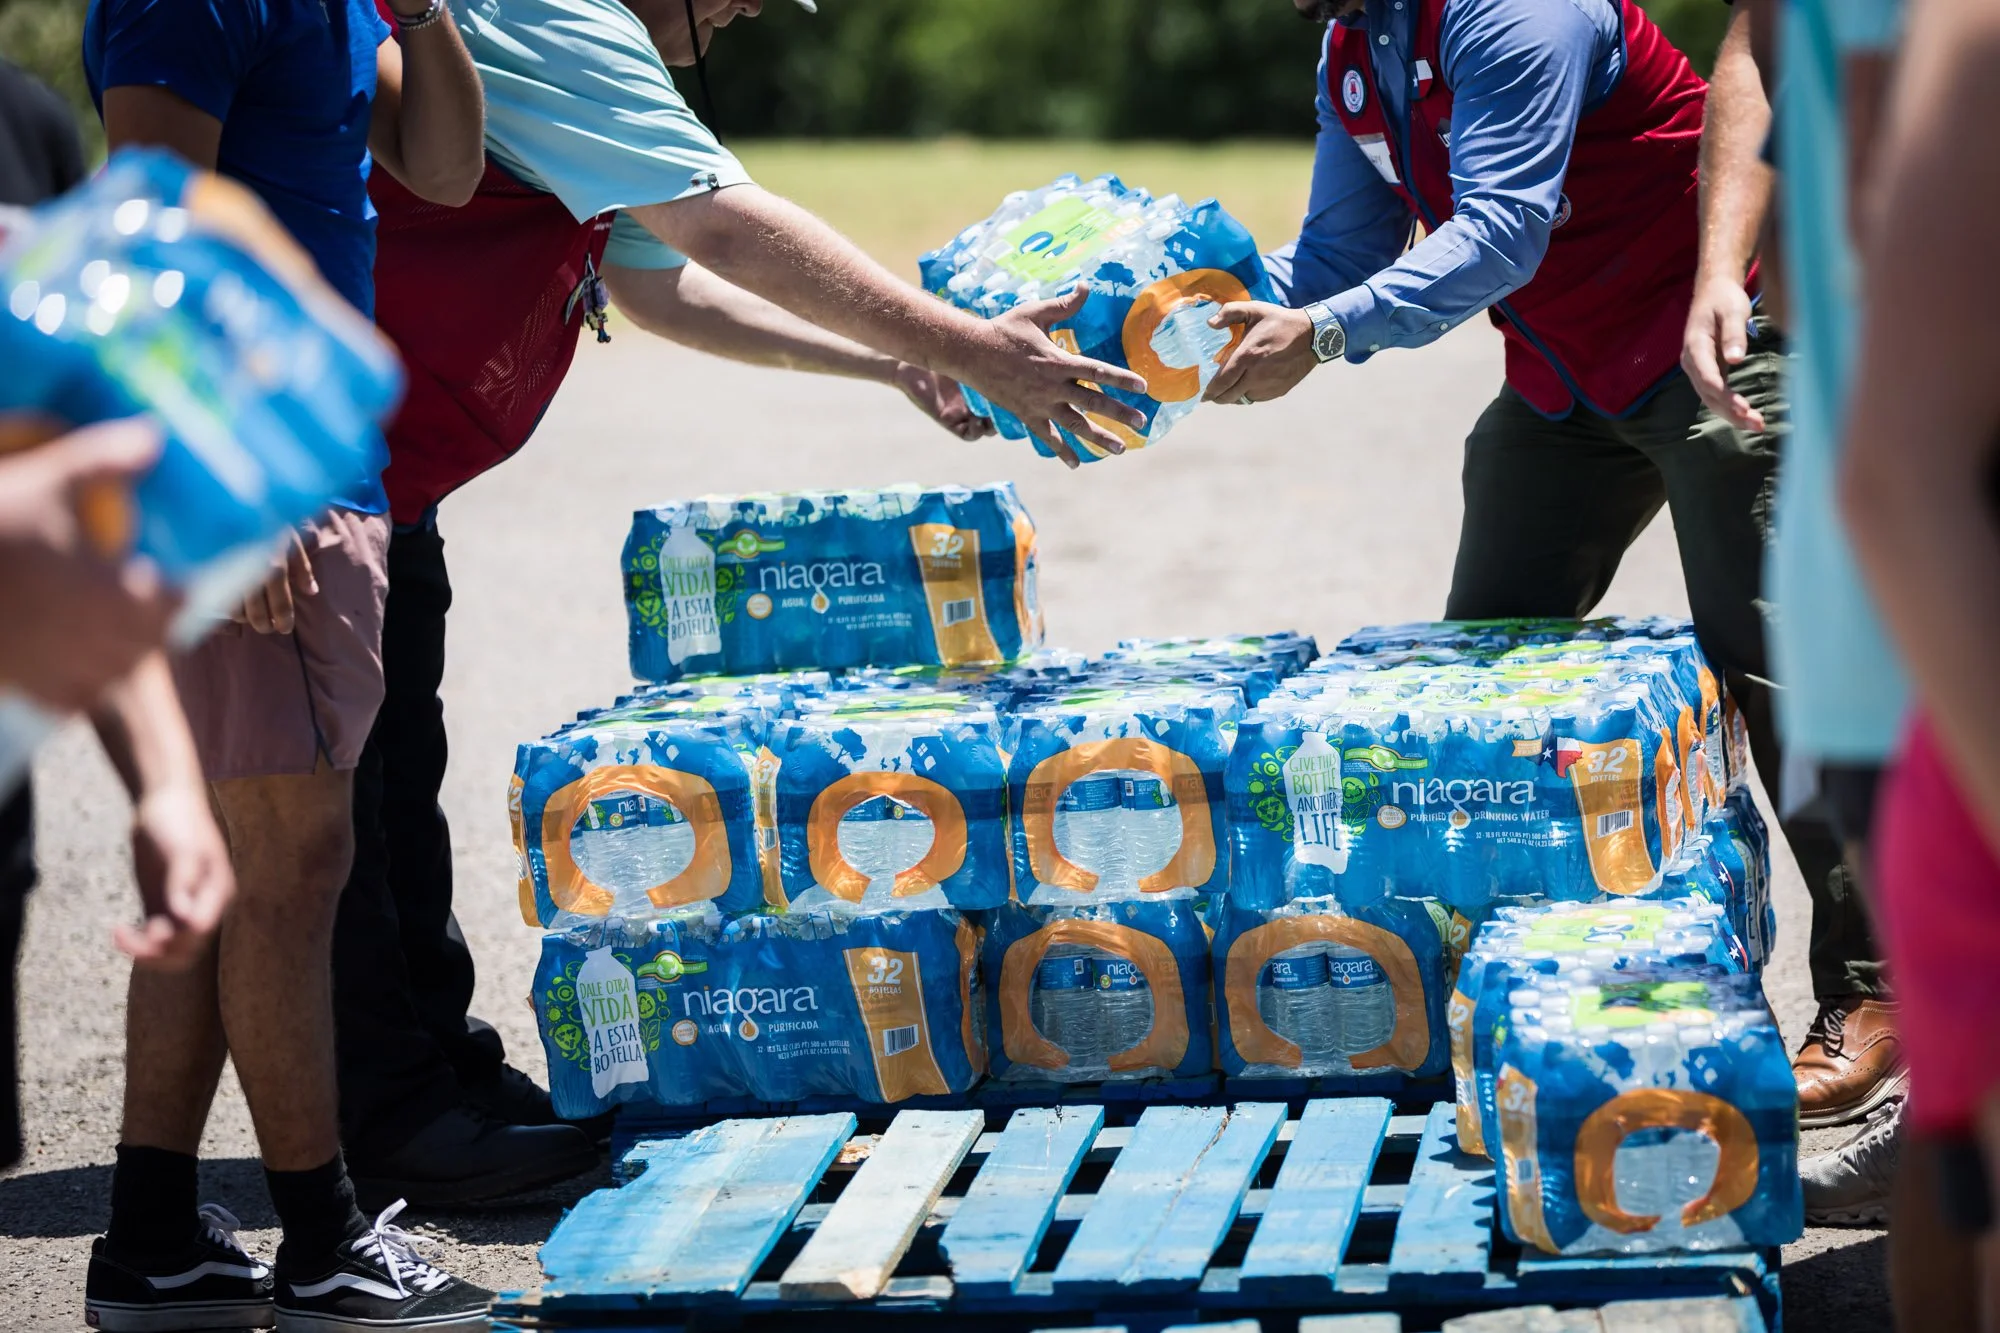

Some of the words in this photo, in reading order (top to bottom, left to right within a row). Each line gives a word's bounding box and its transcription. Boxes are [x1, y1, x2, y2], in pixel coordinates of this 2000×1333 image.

[930, 532, 964, 559] 32
[664, 569, 712, 597] VIDA
[760, 561, 885, 614] niagara
[672, 599, 680, 620] A
[685, 597, 712, 617] ESTA
[838, 594, 886, 605] PURIFICADA
[671, 617, 716, 641] BOTELLA
[1289, 757, 1315, 772] GIVE
[1318, 753, 1337, 768] THIS
[1588, 746, 1628, 773] 32
[1292, 768, 1338, 795] BOTTLE
[1590, 774, 1620, 783] BOTTLES
[1297, 792, 1338, 812] ANOTHER
[1392, 778, 1536, 829] niagara
[1410, 812, 1446, 822] PURIFIED
[1474, 811, 1518, 822] DRINKING
[1521, 809, 1550, 821] WATER
[1299, 812, 1341, 851] LIFE
[867, 956, 904, 984] 32
[580, 982, 602, 999] DALE
[606, 978, 630, 994] OTRA
[869, 986, 902, 994] BOTELLAS
[582, 994, 634, 1027] VIDA
[682, 985, 819, 1041] niagara
[594, 1029, 603, 1053] A
[607, 1023, 638, 1046] ESTA
[768, 1021, 819, 1032] PURIFICADA
[593, 1044, 642, 1074] BOTELLA
